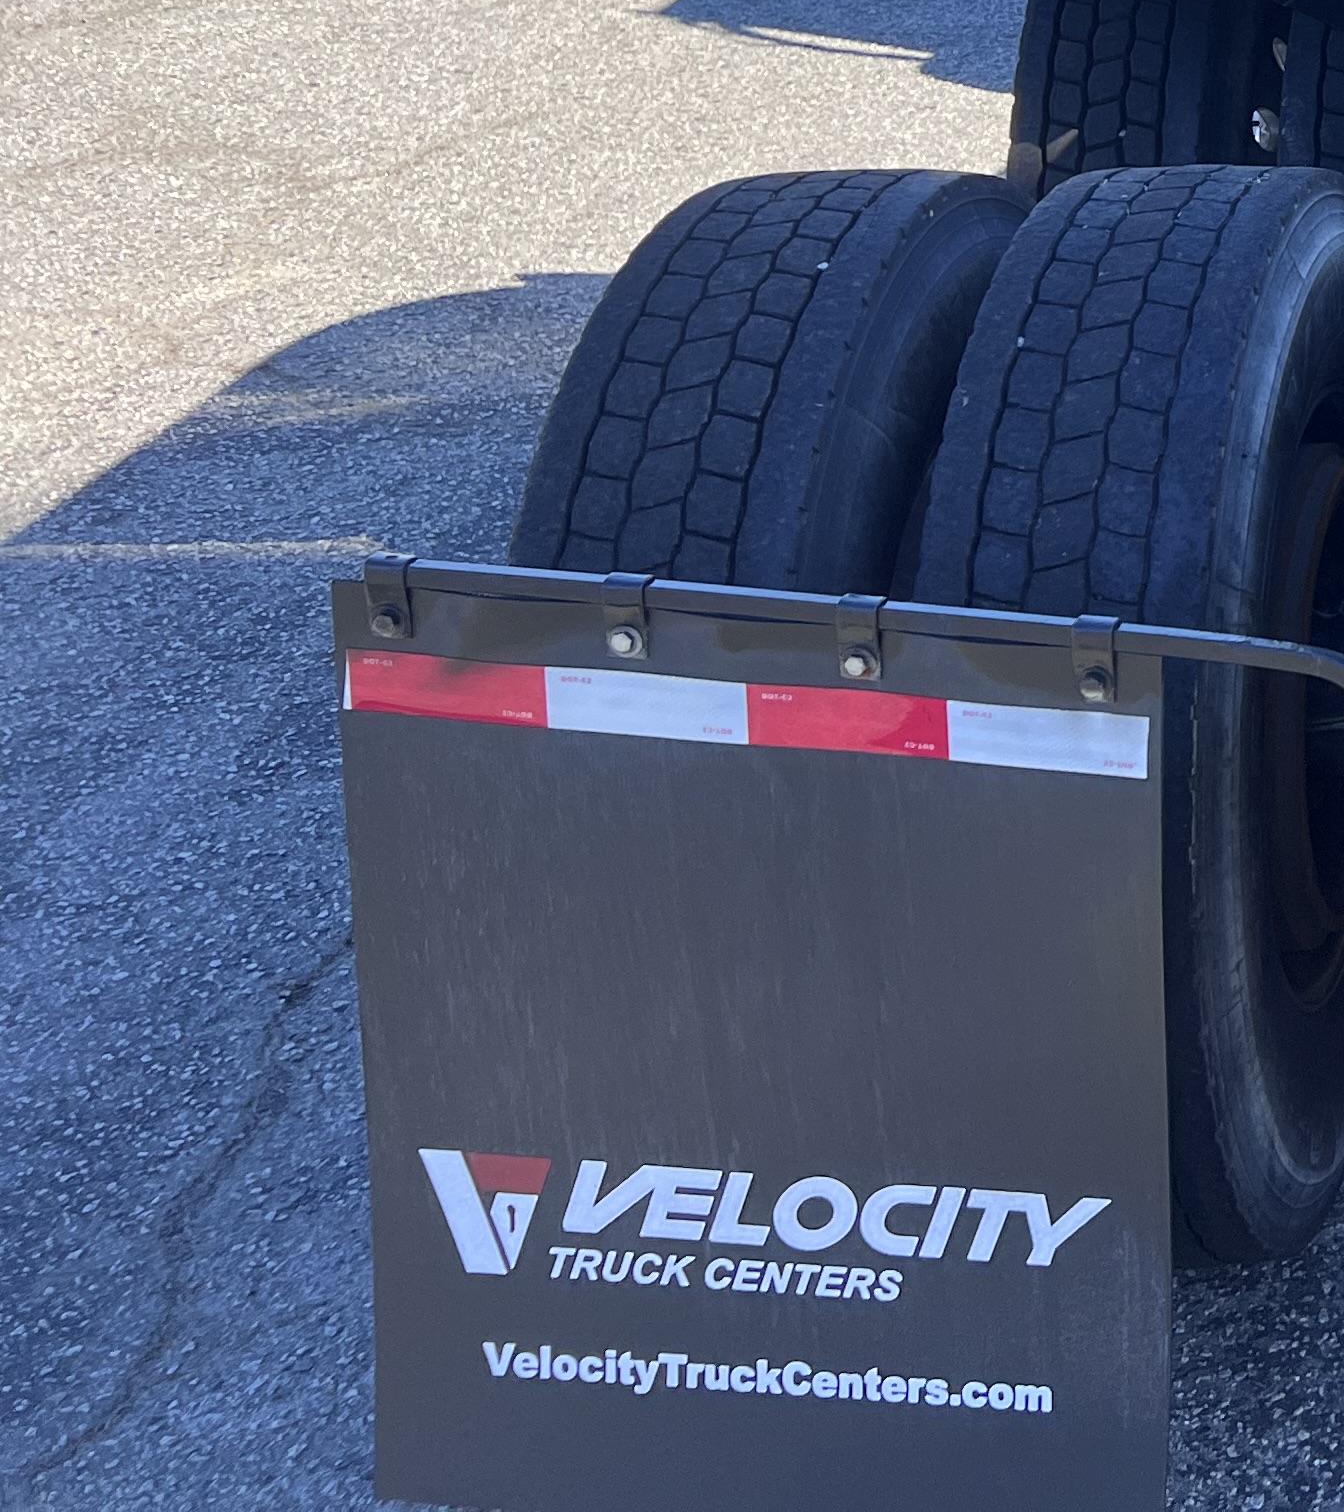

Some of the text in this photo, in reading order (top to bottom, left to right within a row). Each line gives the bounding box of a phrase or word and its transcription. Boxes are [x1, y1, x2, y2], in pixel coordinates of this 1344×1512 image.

[562, 1158, 1112, 1267] VELOCITY
[547, 1245, 903, 1303] TRUCK CENTERS
[482, 1340, 1054, 1414] VelocityTruckCenters.com
